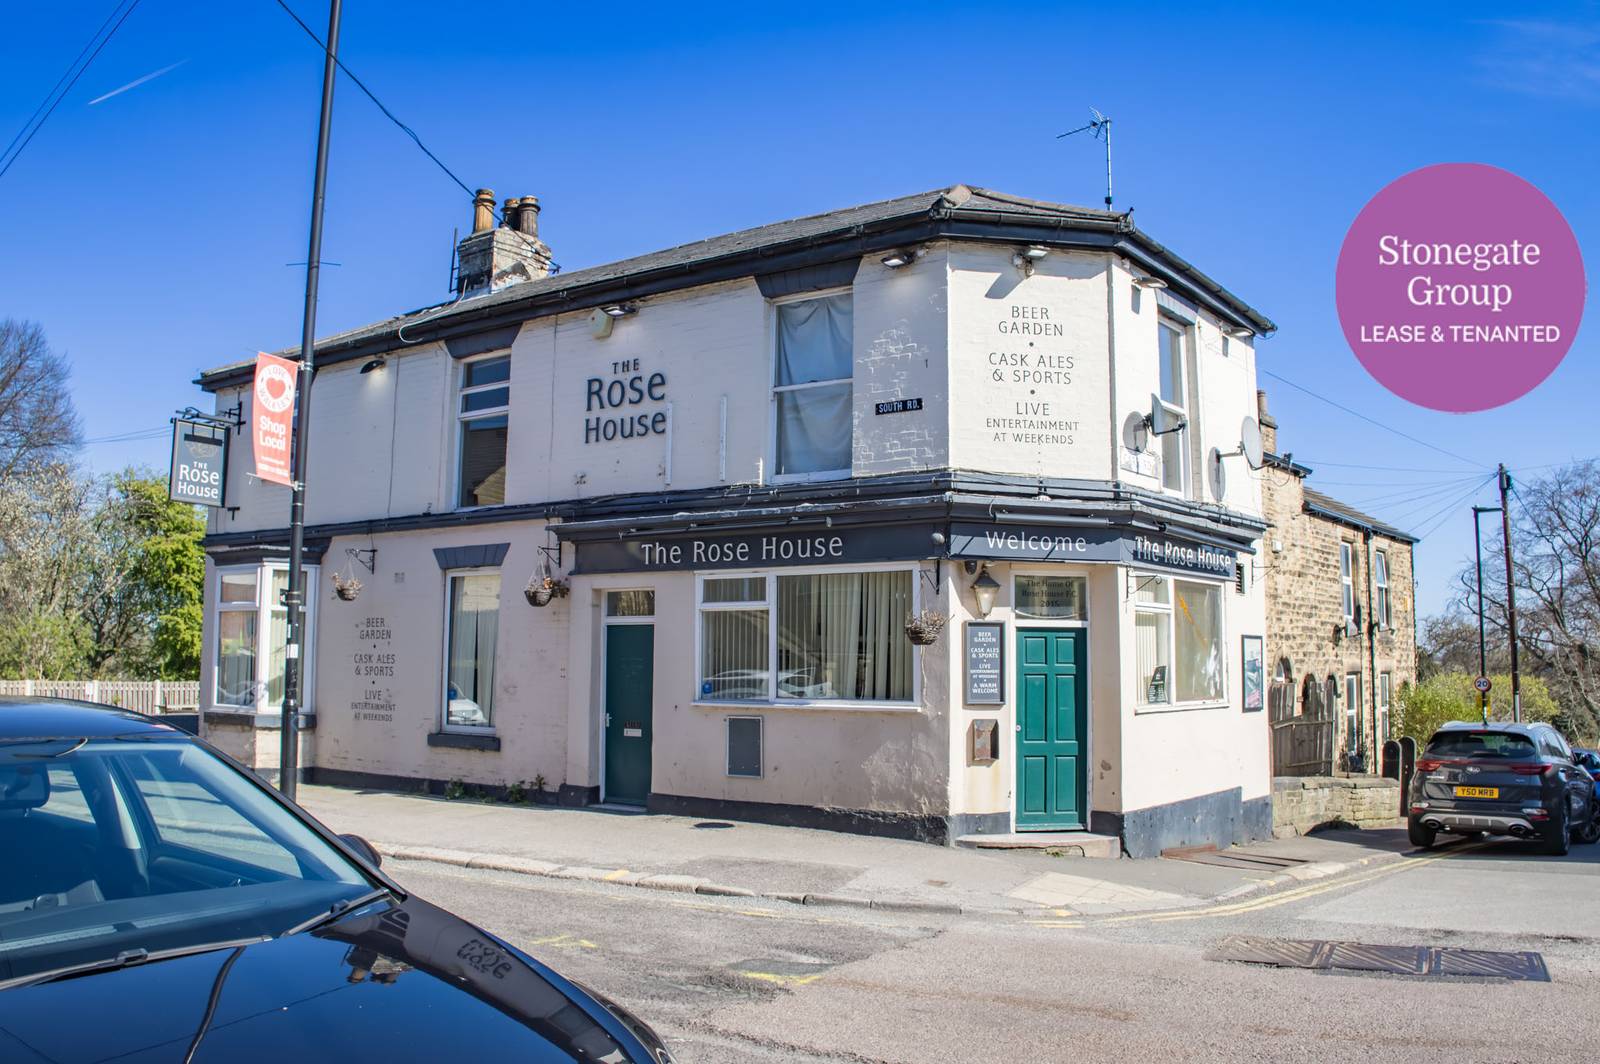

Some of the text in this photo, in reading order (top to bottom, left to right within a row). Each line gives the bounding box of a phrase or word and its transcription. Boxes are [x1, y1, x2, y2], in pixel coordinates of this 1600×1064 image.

[1011, 305, 1049, 320] BEER
[998, 320, 1063, 337] GARDEN
[612, 358, 640, 374] THE
[988, 352, 1074, 369] CASK ALES
[992, 368, 1072, 385] & SPORTS
[586, 372, 666, 412] Rose
[879, 400, 920, 413] SOUTH RD.
[1016, 401, 1050, 416] LIVE
[260, 415, 286, 438] Shop
[585, 412, 667, 444] House
[986, 417, 1080, 431] ENTERTAINMENT
[259, 431, 286, 451] Local
[993, 432, 1074, 445] AT WEEKENDS
[193, 461, 208, 470] THE
[179, 464, 219, 486] Rose
[177, 481, 219, 499] House
[986, 531, 1087, 552] Welcome
[641, 536, 843, 565] The Rose House
[1135, 535, 1232, 570] The Rose House
[366, 618, 385, 628] BEER
[360, 630, 392, 640] GARDEN
[354, 654, 395, 665] CASK ALES
[364, 665, 394, 677] SPORTS
[1476, 680, 1488, 688] 20
[365, 690, 382, 701] LIVE
